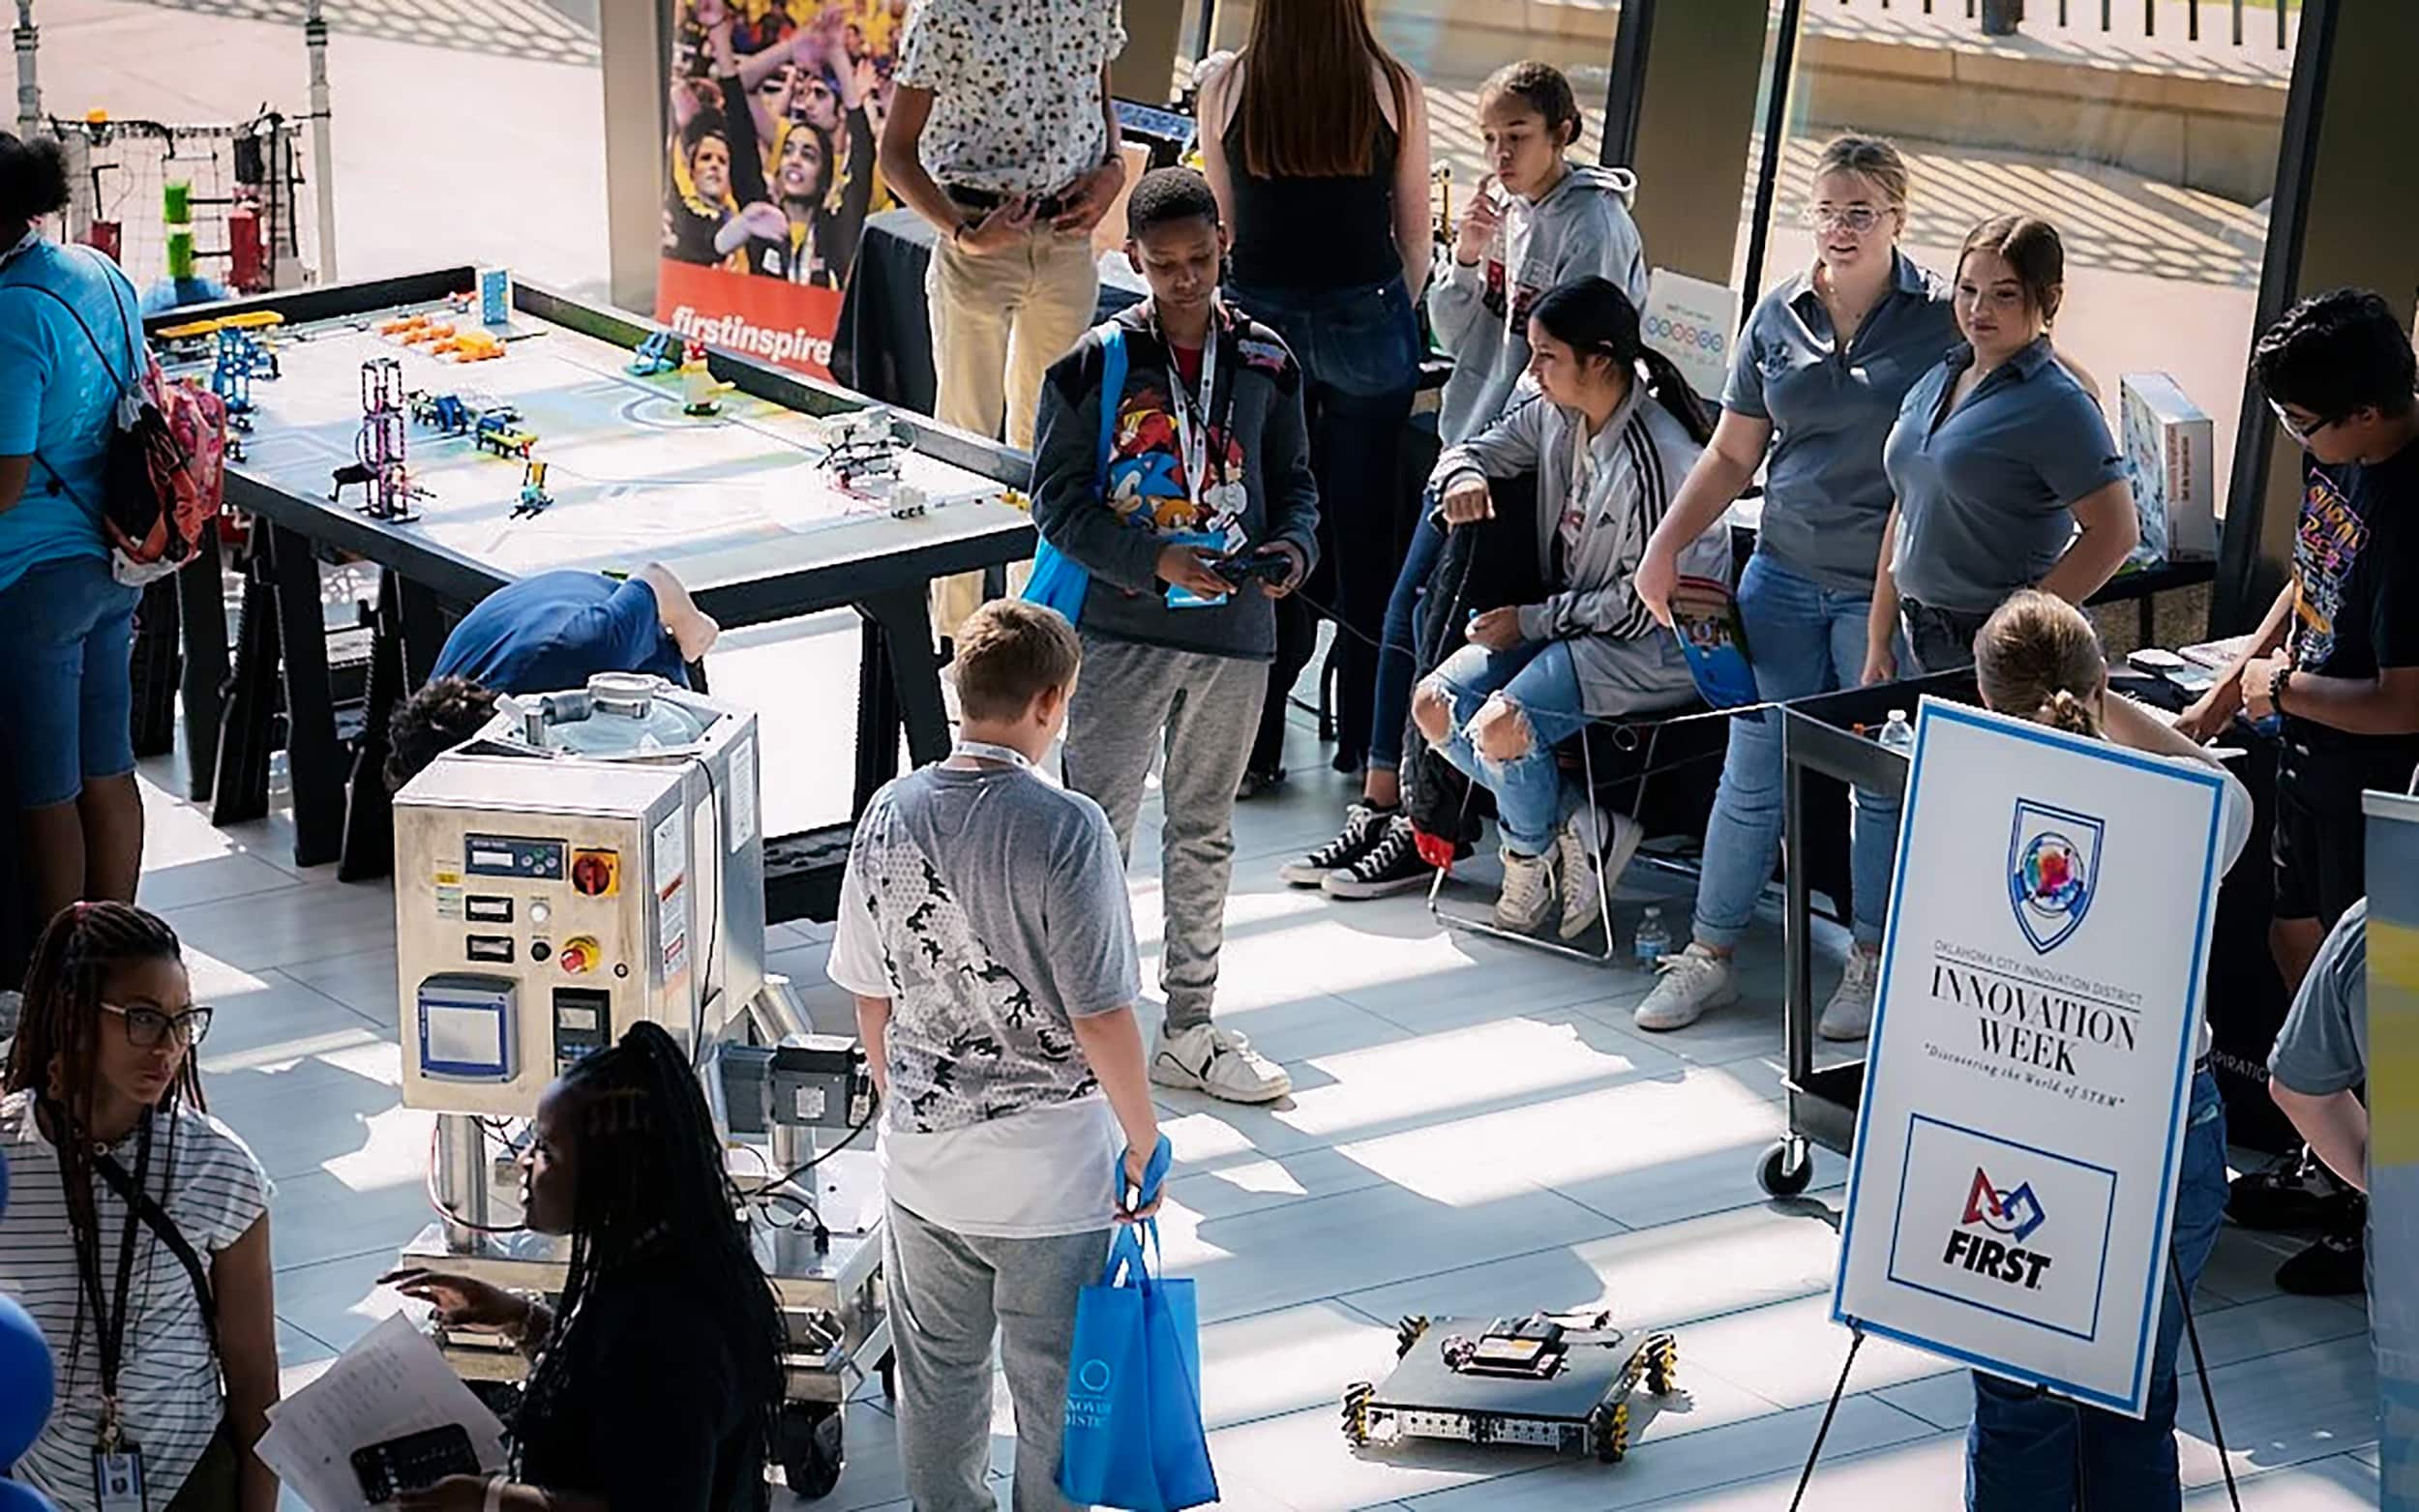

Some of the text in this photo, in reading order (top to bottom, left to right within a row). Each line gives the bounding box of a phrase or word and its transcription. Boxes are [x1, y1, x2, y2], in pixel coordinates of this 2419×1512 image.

[1934, 939, 2143, 1006] OKLAHOMA CITY INNOVATION DISTRICT
[1931, 964, 2140, 1052] INNOVATION
[1979, 1017, 2078, 1077] WEEK
[2001, 1067, 2020, 1081] the
[2024, 1073, 2061, 1092] World
[2063, 1083, 2078, 1100] of
[1943, 1229, 2051, 1290] FIRST
